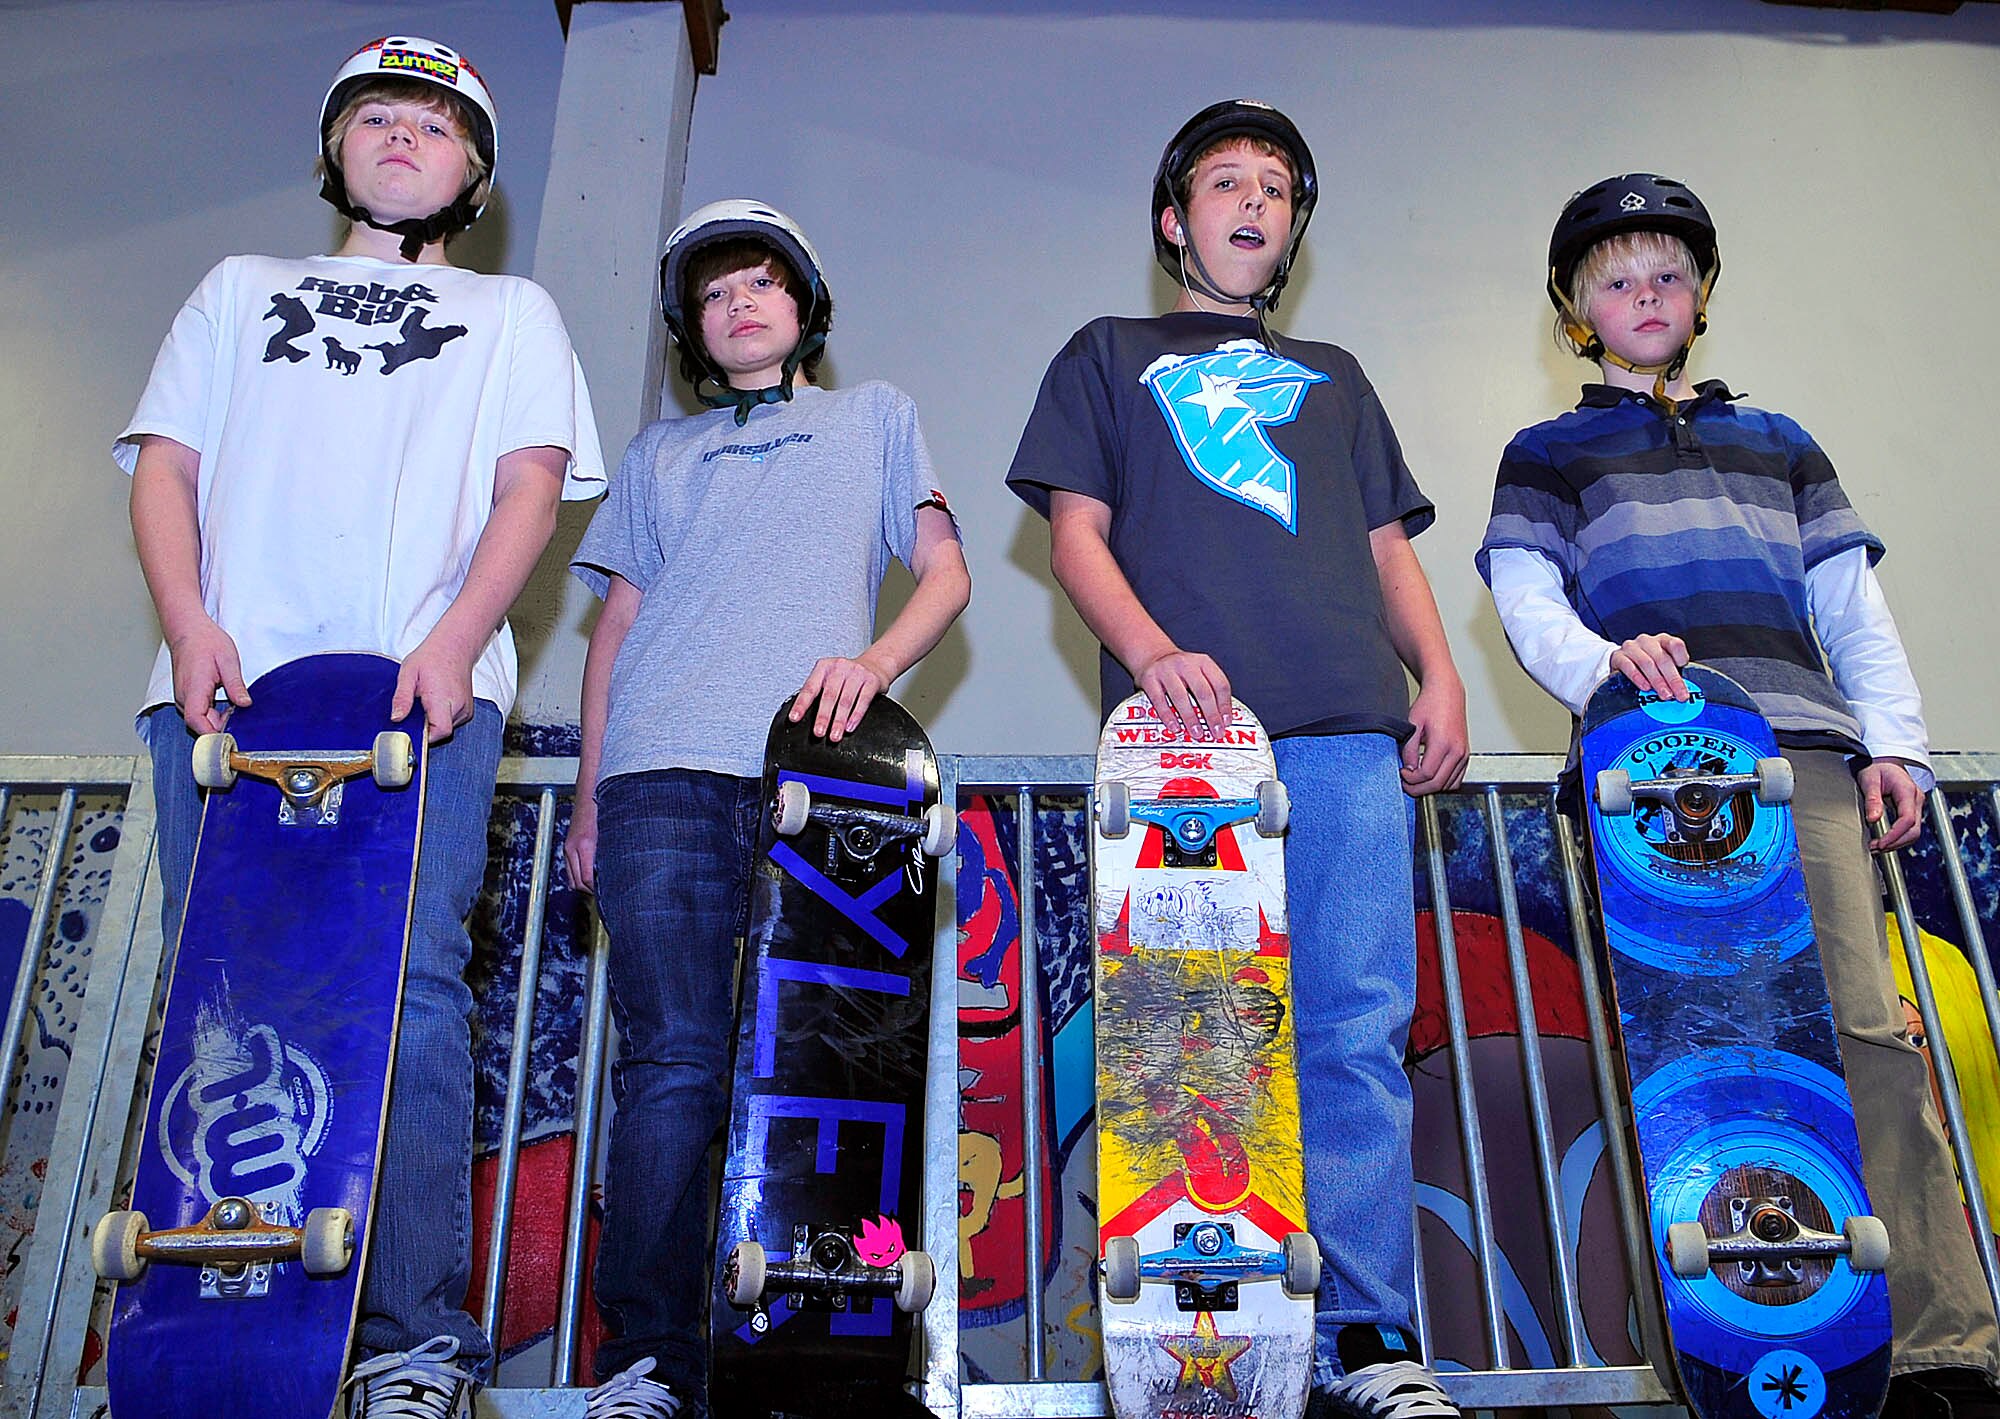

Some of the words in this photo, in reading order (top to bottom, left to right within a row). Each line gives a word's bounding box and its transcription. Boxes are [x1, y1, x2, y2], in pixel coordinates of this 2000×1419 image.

[383, 54, 457, 78] zumiez
[315, 294, 409, 326] Big
[1160, 752, 1214, 770] DGK
[1630, 734, 1738, 764] COOPER
